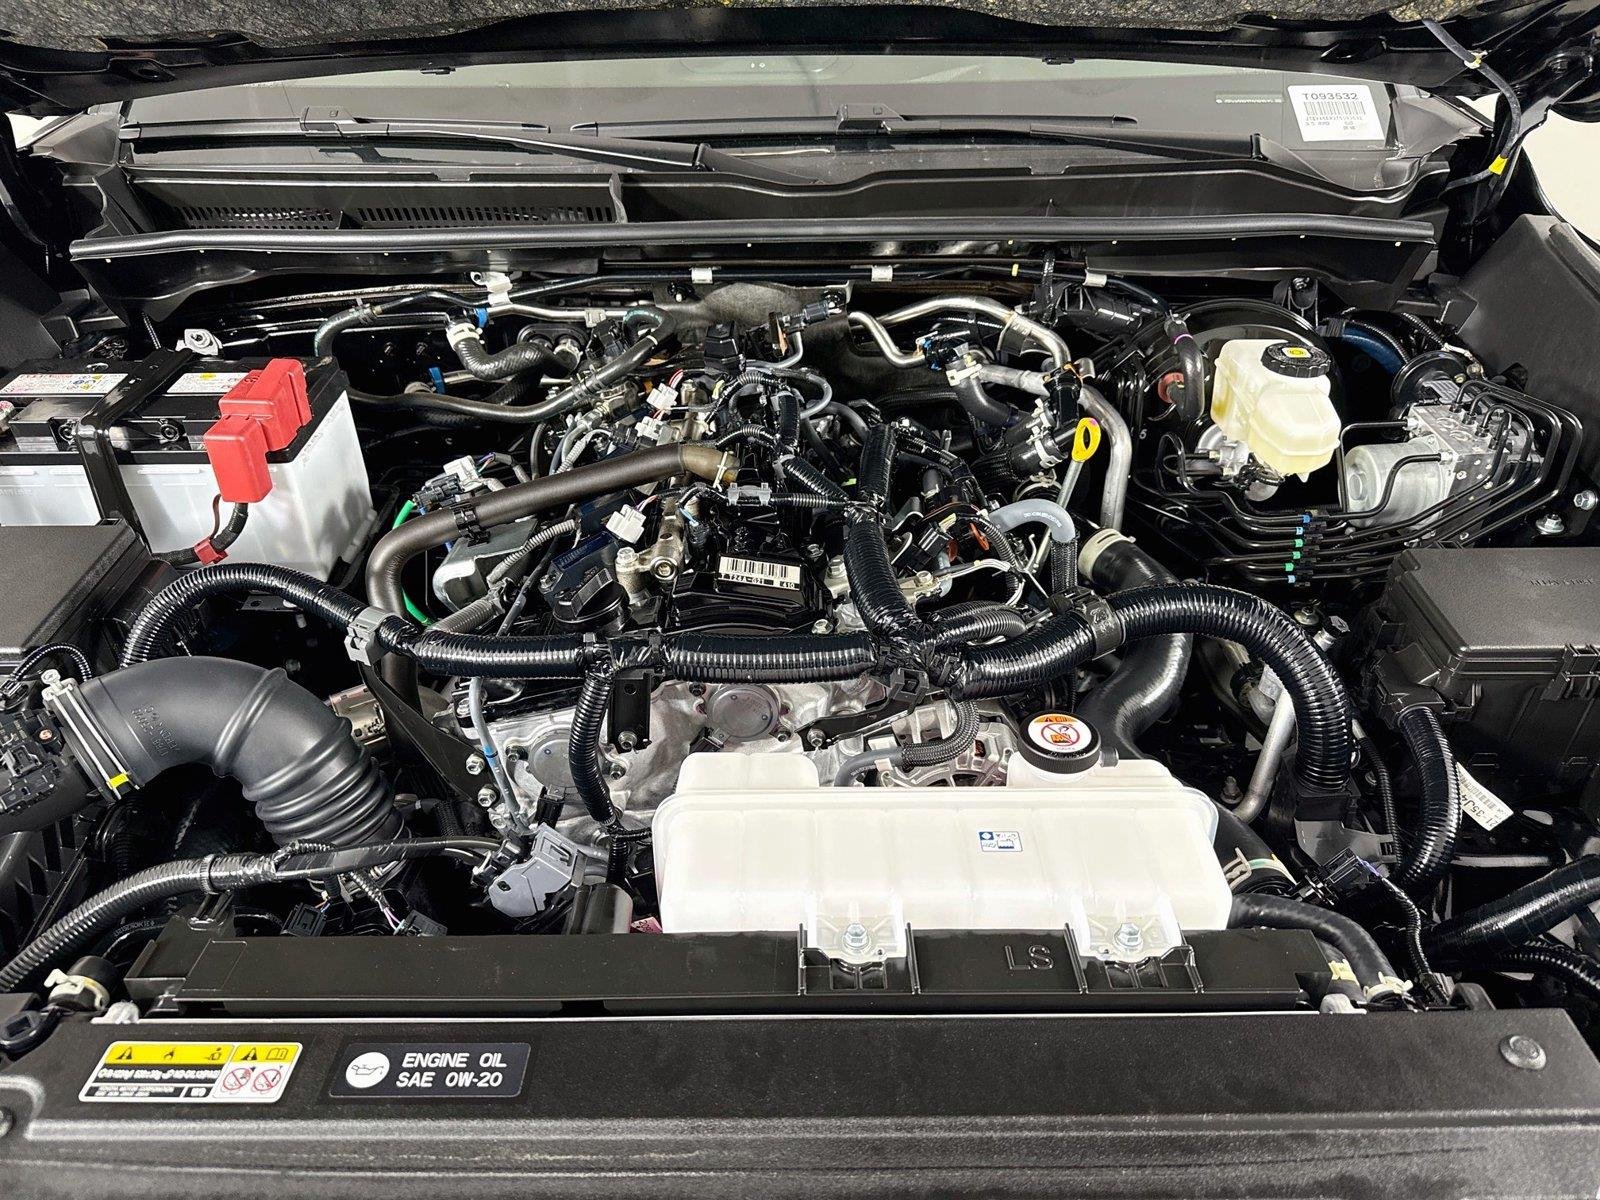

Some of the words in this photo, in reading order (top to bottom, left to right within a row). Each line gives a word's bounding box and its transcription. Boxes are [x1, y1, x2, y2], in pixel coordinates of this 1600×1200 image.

[1004, 944, 1054, 970] LS
[402, 1052, 470, 1067] ENGINE
[479, 1053, 507, 1067] OIL
[396, 1071, 436, 1087] SAE
[445, 1071, 503, 1087] 0W-20
